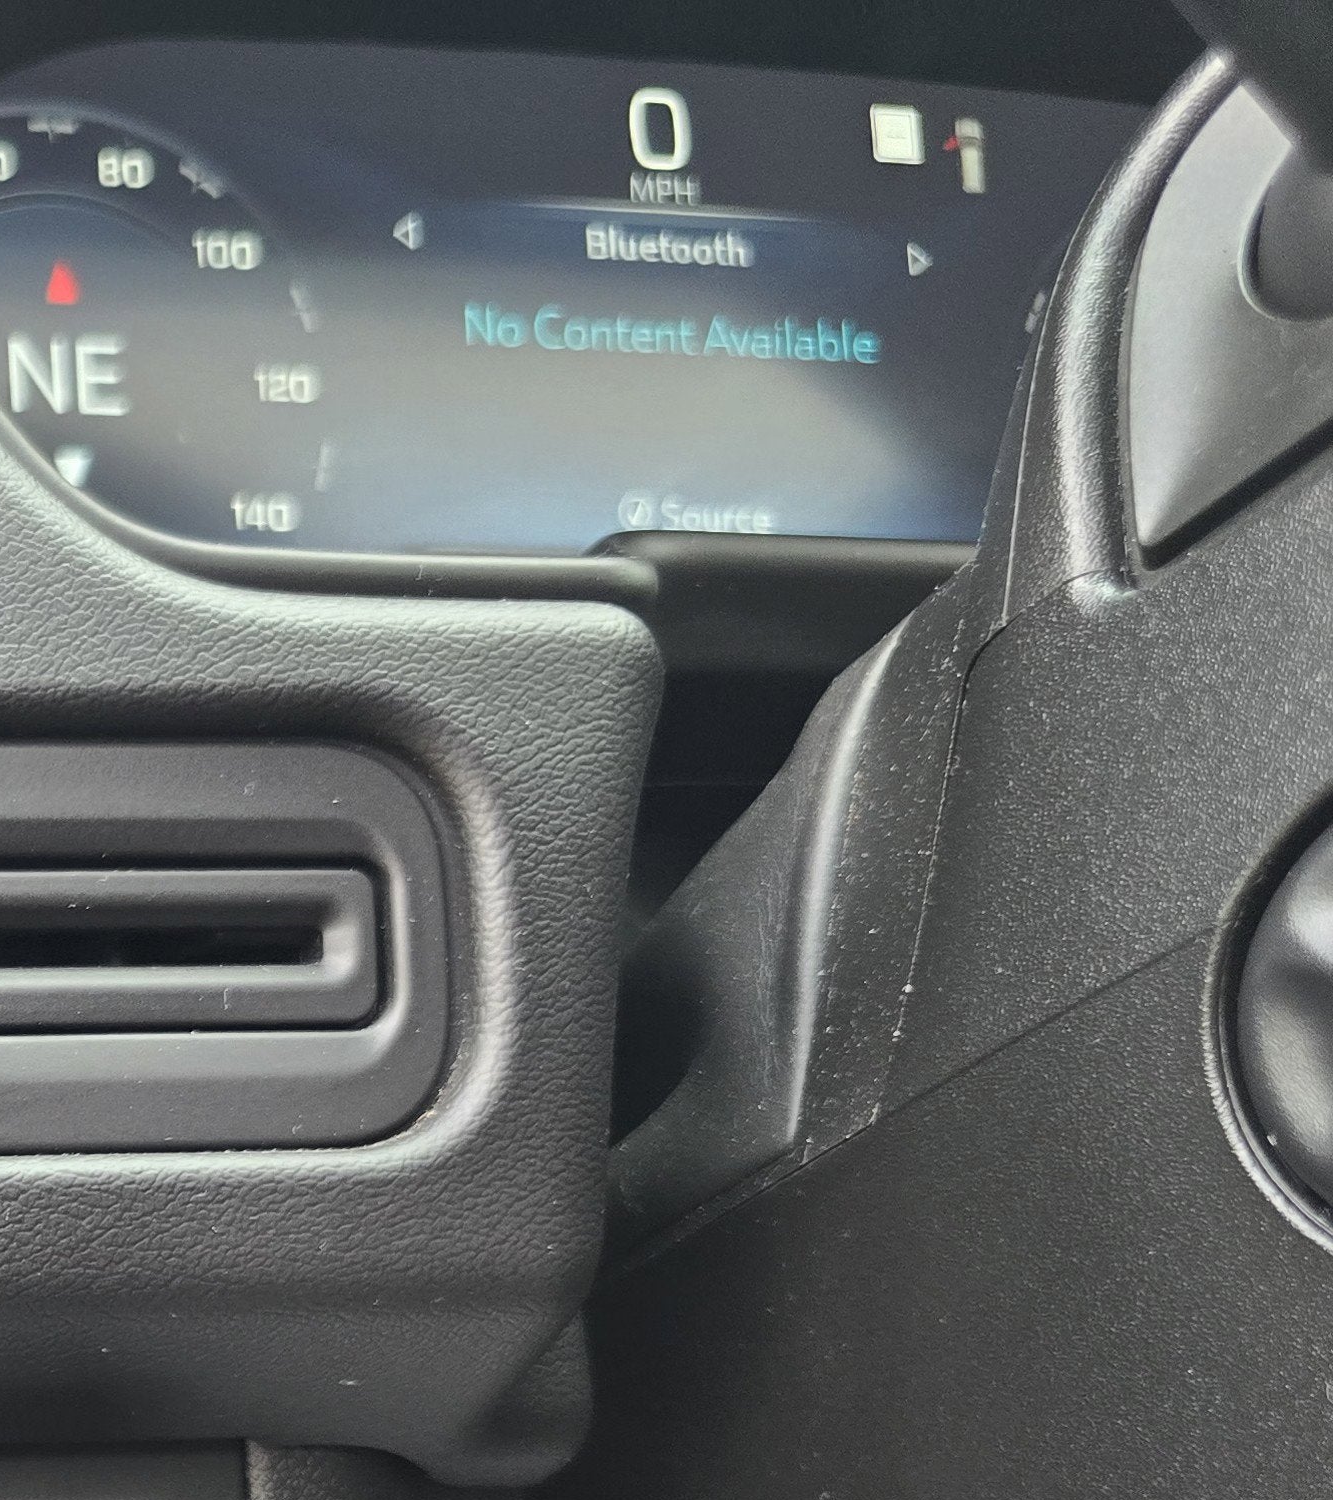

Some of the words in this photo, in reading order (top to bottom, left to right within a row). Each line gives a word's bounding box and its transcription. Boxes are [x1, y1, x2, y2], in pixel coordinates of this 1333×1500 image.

[629, 87, 693, 170] 0
[97, 145, 156, 189] 80
[629, 172, 701, 206] MPH
[192, 228, 265, 271] 100
[585, 223, 755, 268] Bluetooth
[463, 302, 527, 349] No
[534, 305, 699, 356] Content
[703, 316, 883, 364] Available
[6, 331, 130, 417] NE
[253, 362, 323, 404] 120
[229, 490, 302, 533] 140
[660, 496, 775, 534] Source
